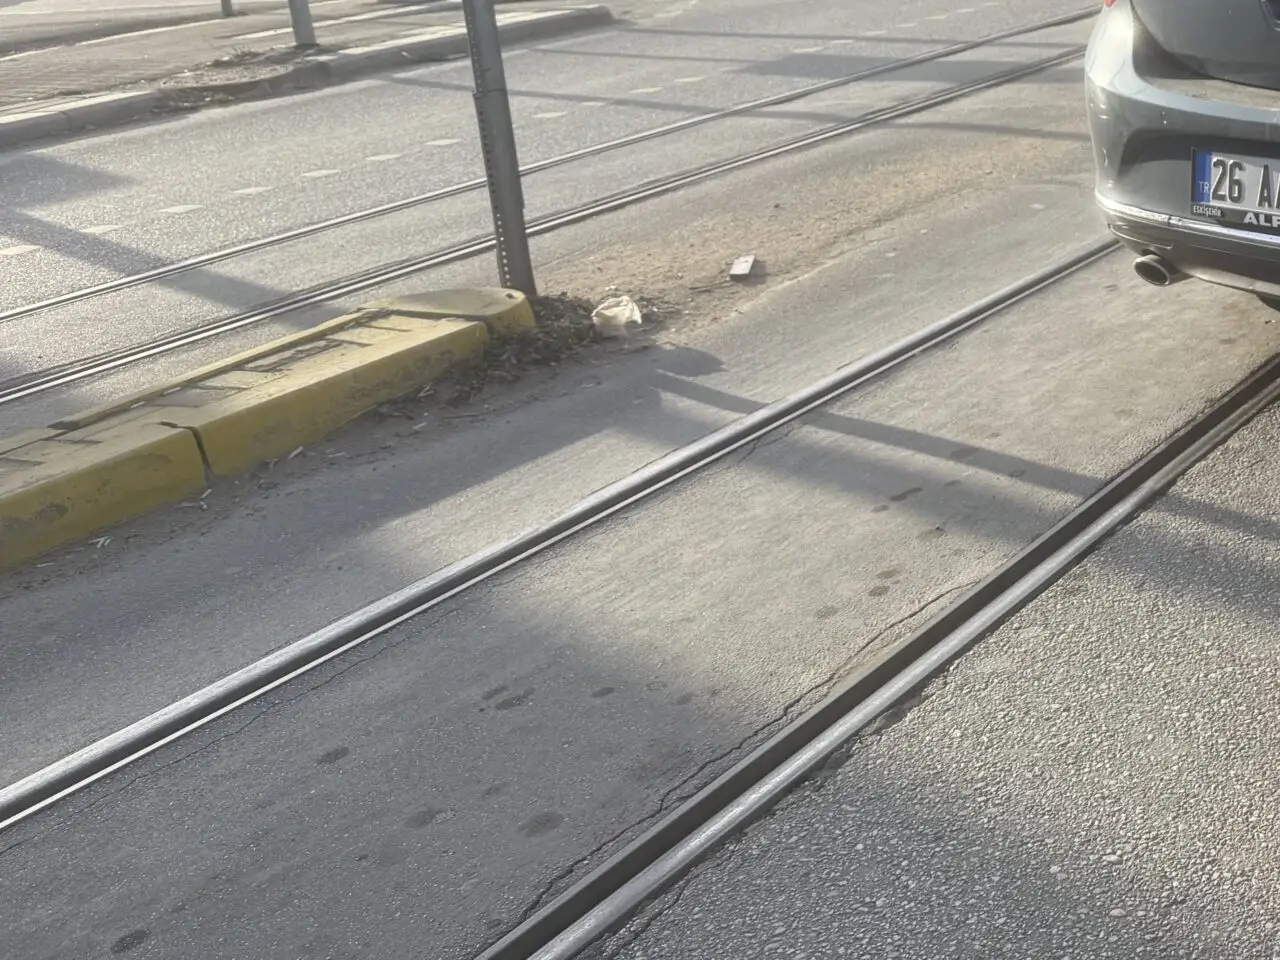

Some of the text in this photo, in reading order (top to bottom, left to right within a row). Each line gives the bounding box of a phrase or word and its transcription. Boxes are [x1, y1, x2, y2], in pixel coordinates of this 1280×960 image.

[1198, 181, 1210, 194] TR
[1211, 158, 1245, 204] 26
[1192, 204, 1223, 217] ESKİŞEHİR
